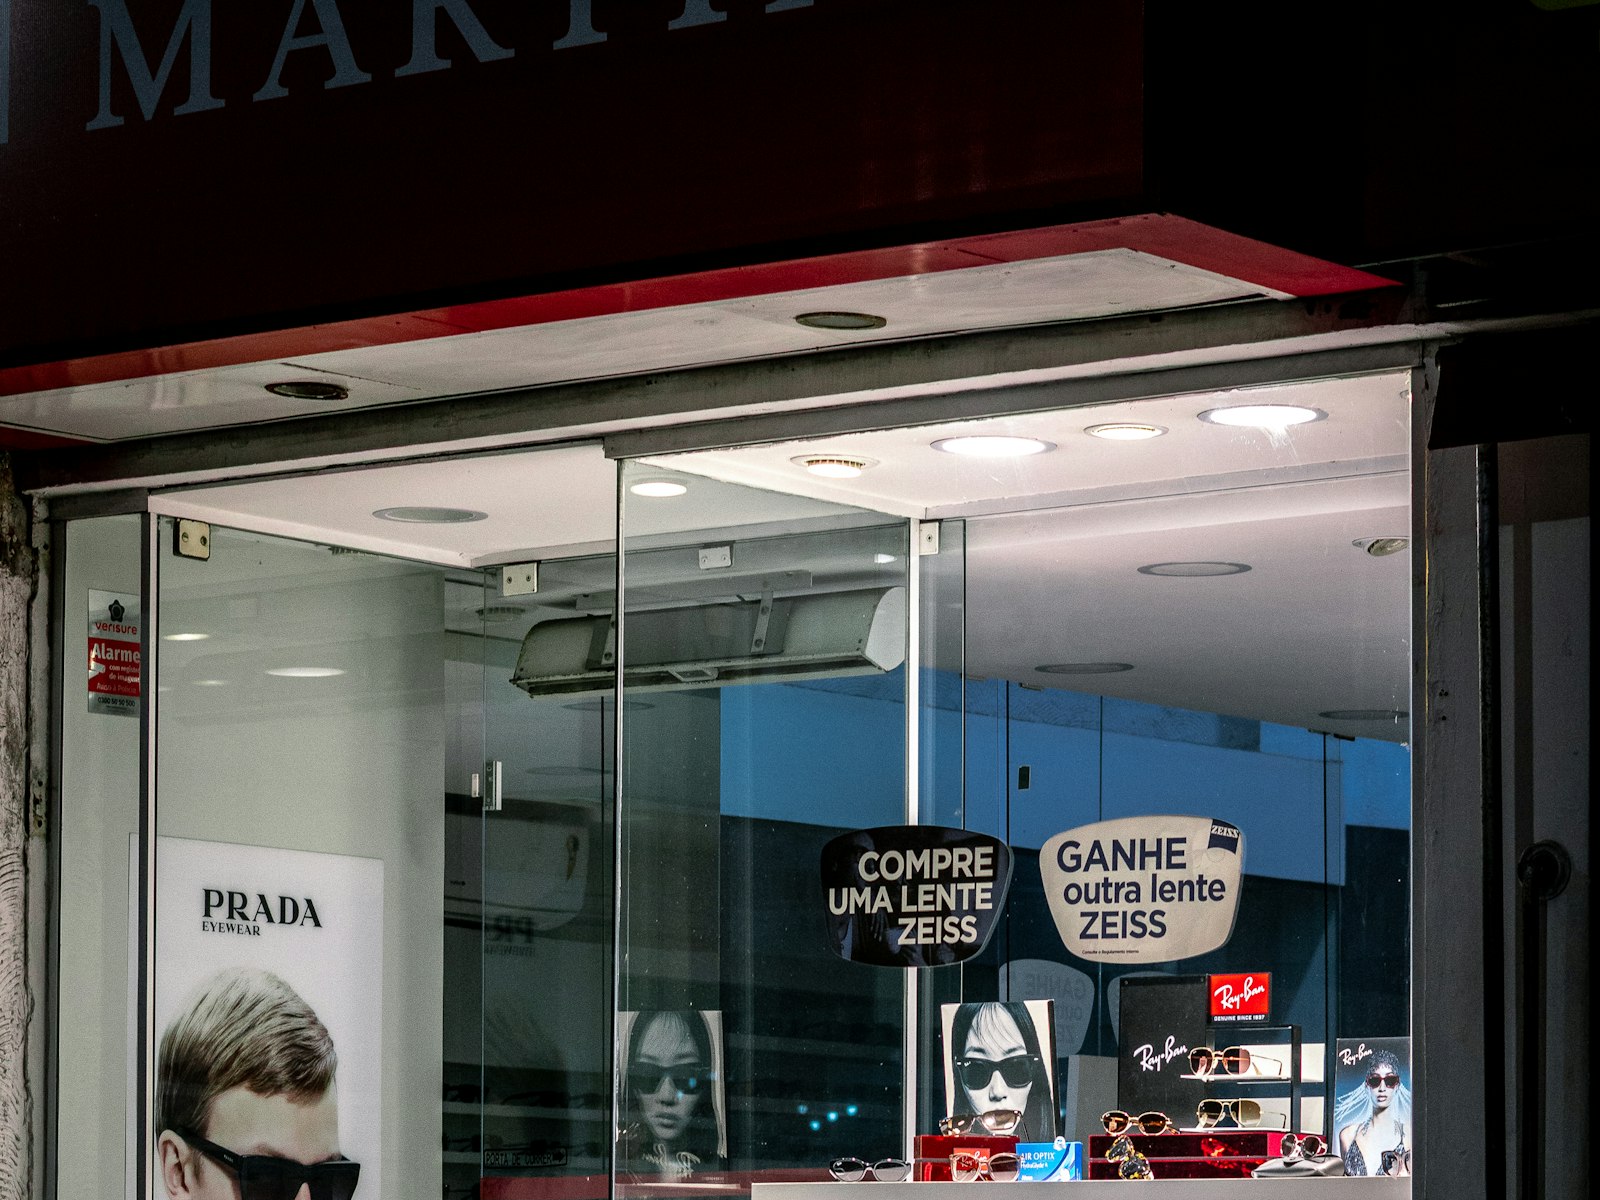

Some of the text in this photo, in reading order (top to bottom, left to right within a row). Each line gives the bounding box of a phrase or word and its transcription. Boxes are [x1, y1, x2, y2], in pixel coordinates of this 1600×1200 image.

[95, 621, 138, 635] verisure
[91, 643, 140, 663] Alarme
[1210, 825, 1240, 839] ZEISS
[857, 846, 994, 883] COMPRE
[1056, 837, 1187, 872] GANHE
[828, 882, 993, 916] UMA LENTE
[1063, 873, 1226, 905] outra lente
[202, 888, 323, 928] PRADA
[202, 921, 261, 936] EYEWEAR
[897, 915, 978, 946] ZEISS
[1079, 910, 1167, 940] ZEISS
[1033, 1152, 1055, 1161] OPTIX
